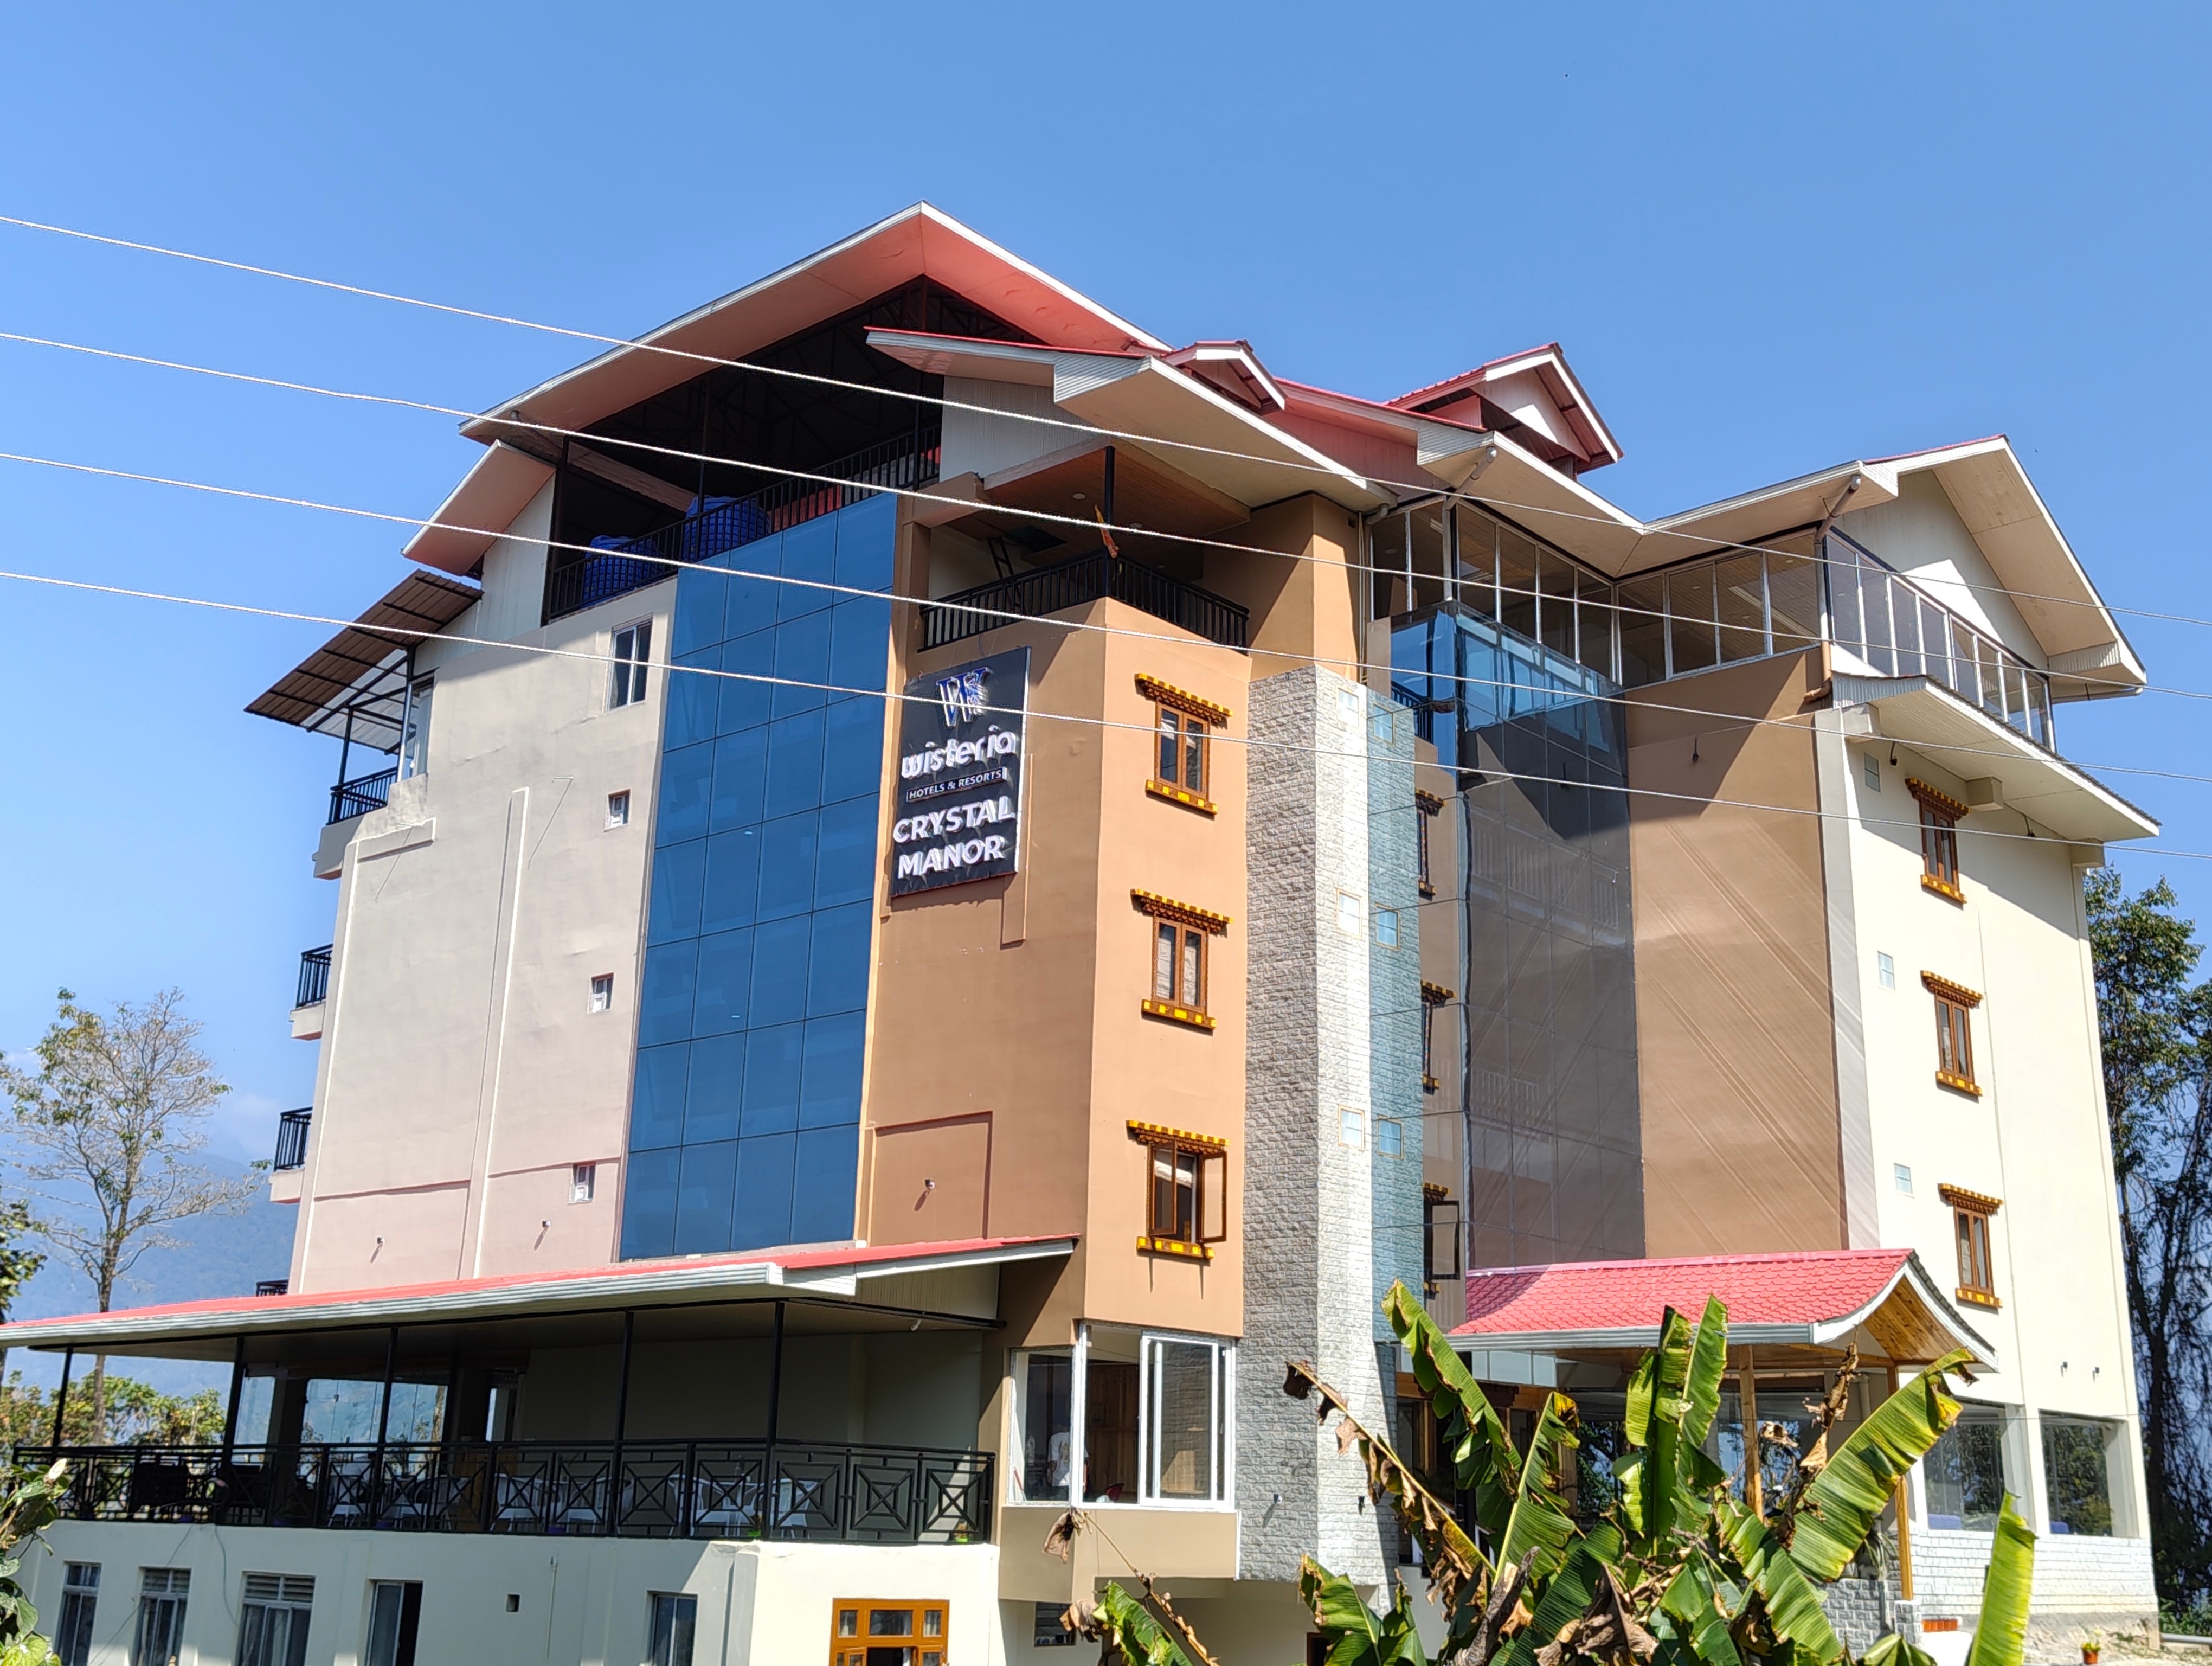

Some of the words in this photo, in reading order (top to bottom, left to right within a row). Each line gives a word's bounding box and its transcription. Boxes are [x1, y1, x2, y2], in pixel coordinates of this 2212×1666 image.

[909, 784, 944, 799] HOTELS
[947, 781, 955, 790] &
[959, 770, 1002, 787] RESORTS
[893, 796, 1015, 843] CRYSTAL
[898, 834, 1006, 879] MANOR
